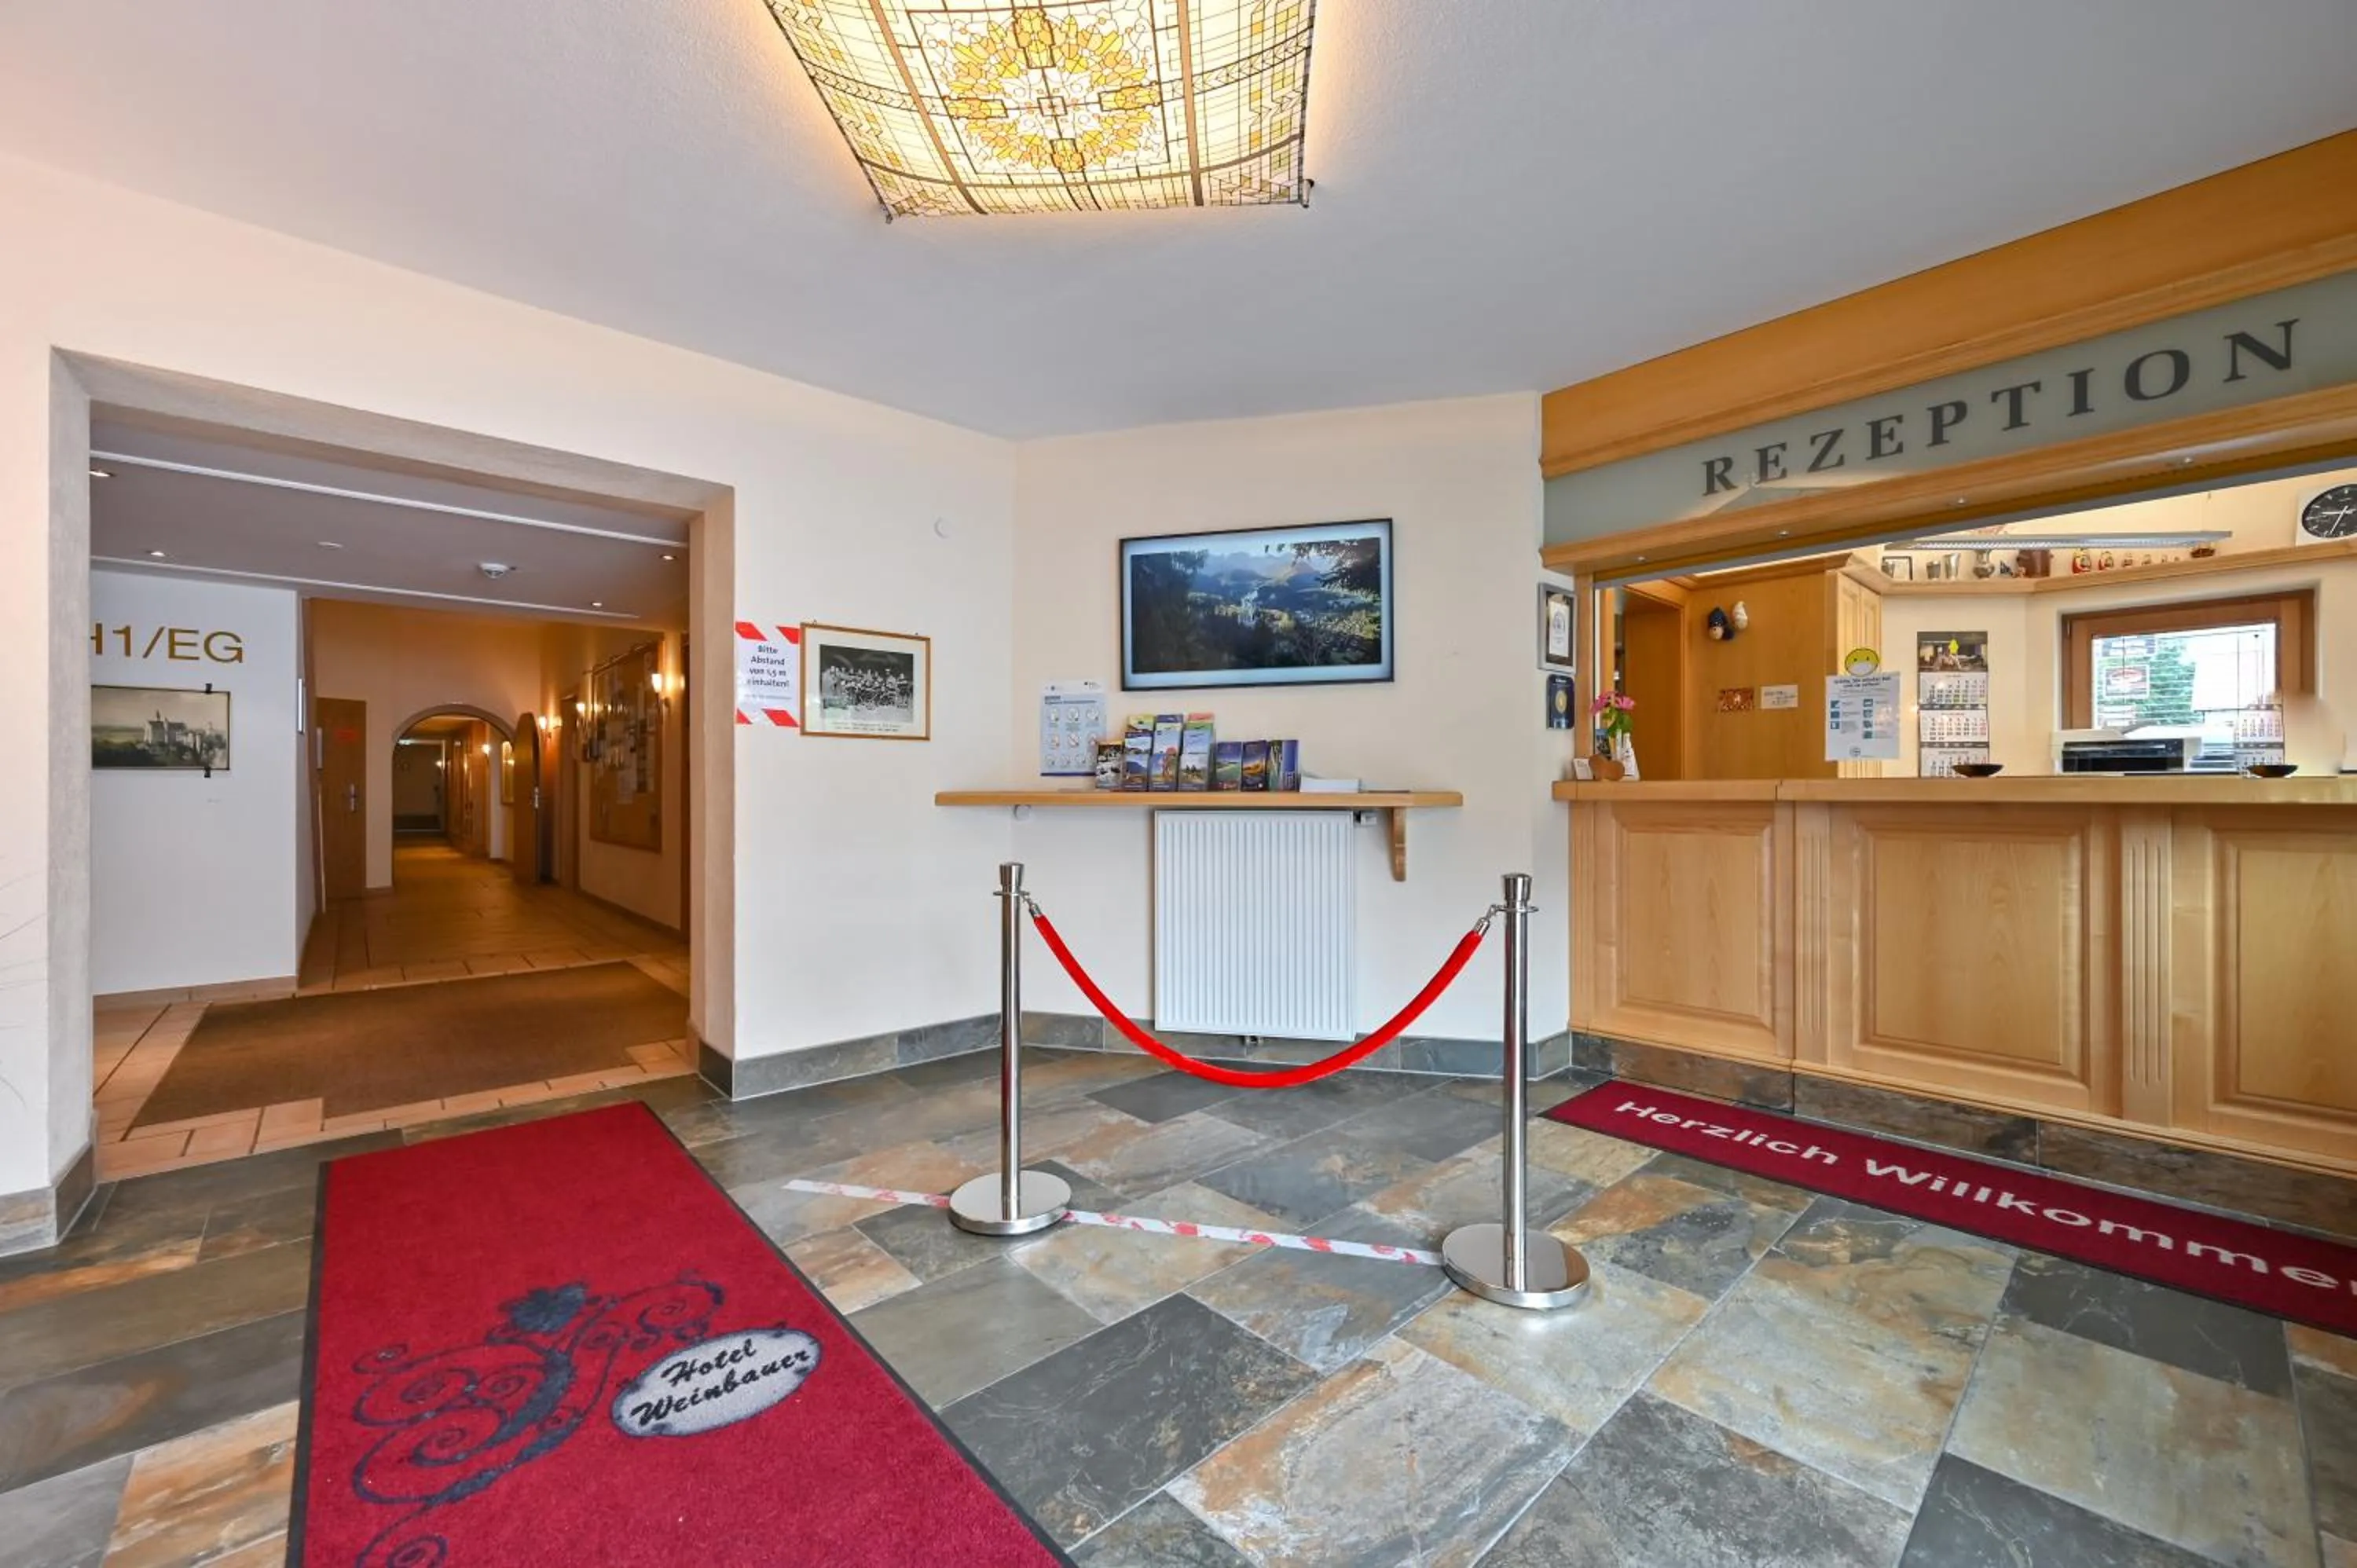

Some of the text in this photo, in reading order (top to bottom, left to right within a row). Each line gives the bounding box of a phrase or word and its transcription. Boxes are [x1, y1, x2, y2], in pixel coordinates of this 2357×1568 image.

[1701, 318, 2301, 497] REZEPTION
[750, 655, 785, 665] Abstand
[757, 644, 779, 654] Bitte
[766, 669, 777, 678] 1,5
[1613, 1100, 2357, 1296] Herzlich Willkomme
[661, 1339, 756, 1387] Hotel
[631, 1350, 811, 1426] Weinbauer
